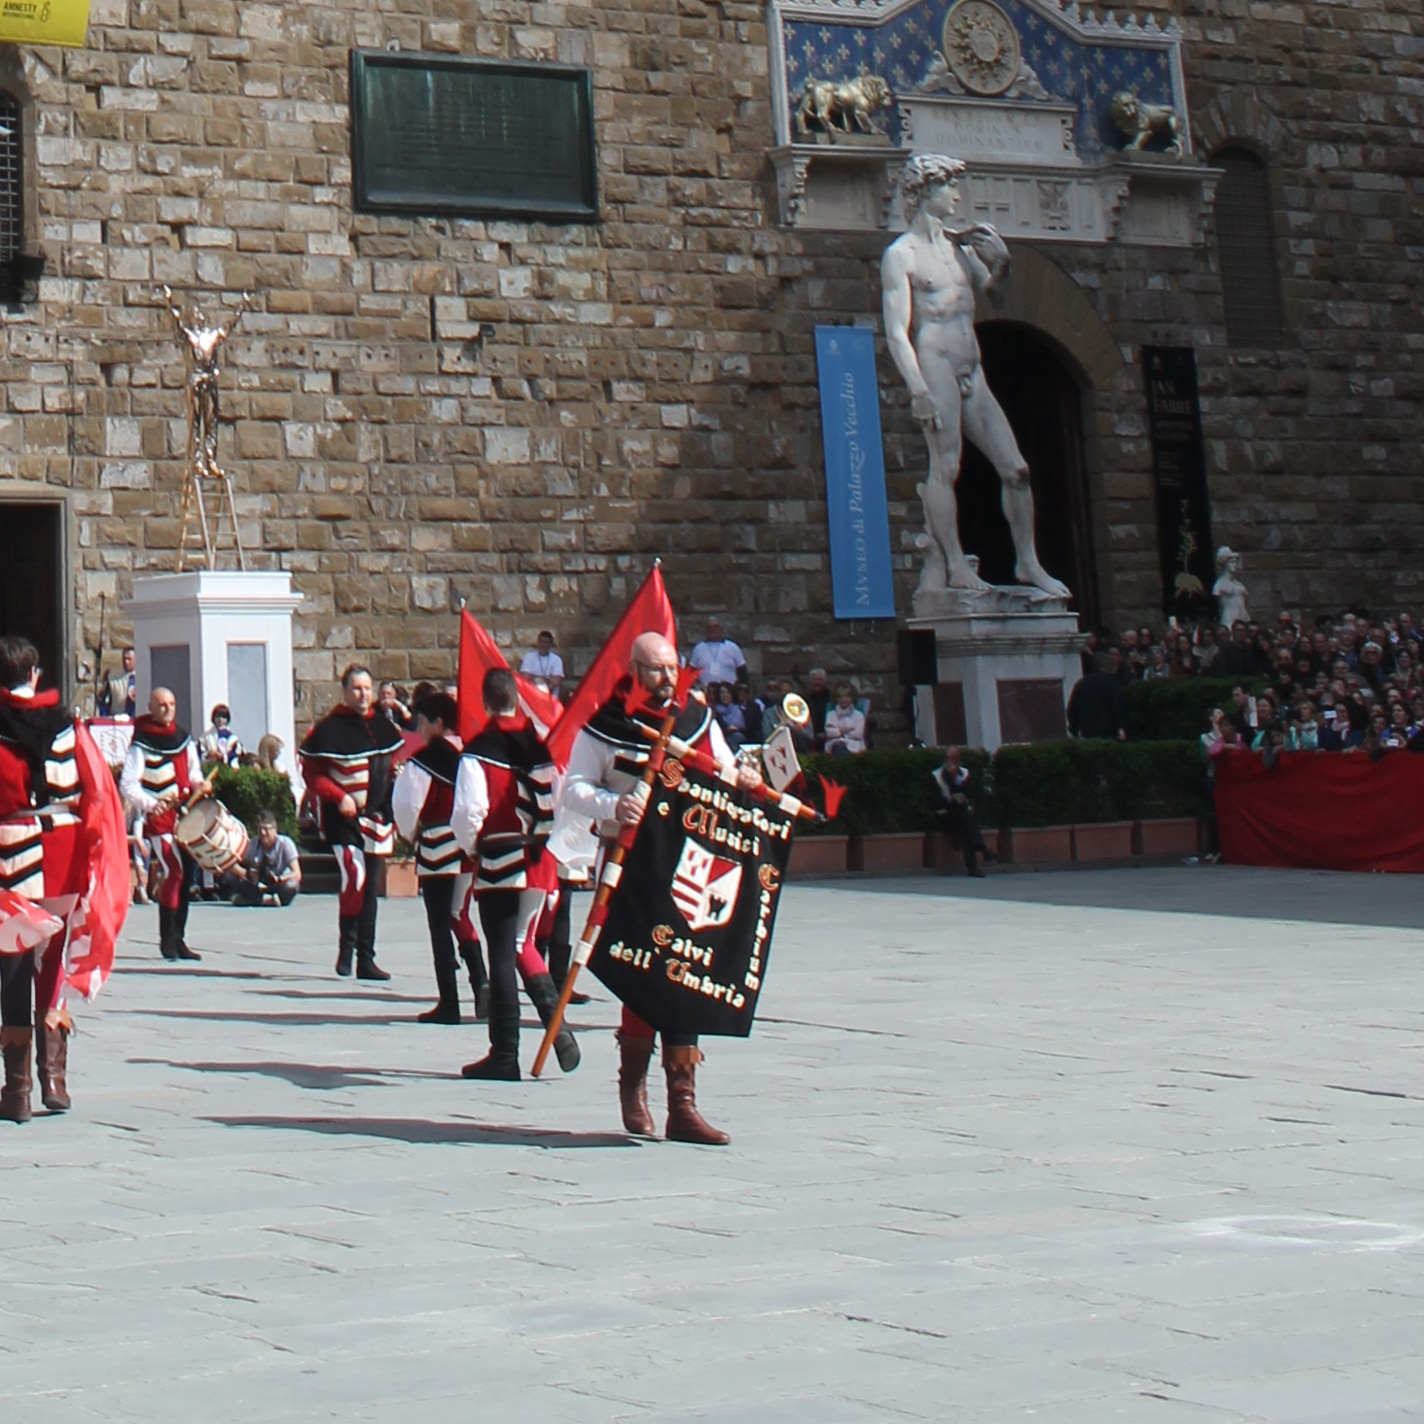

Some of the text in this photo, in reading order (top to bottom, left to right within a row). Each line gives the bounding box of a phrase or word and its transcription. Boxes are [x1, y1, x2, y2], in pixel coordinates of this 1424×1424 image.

[3, 1, 38, 13] AMNESTY
[840, 372, 859, 438] Vecchio
[1153, 399, 1193, 414] FABRE
[848, 441, 866, 514] Palazzo
[657, 801, 671, 817] e
[651, 923, 715, 968] Calvi
